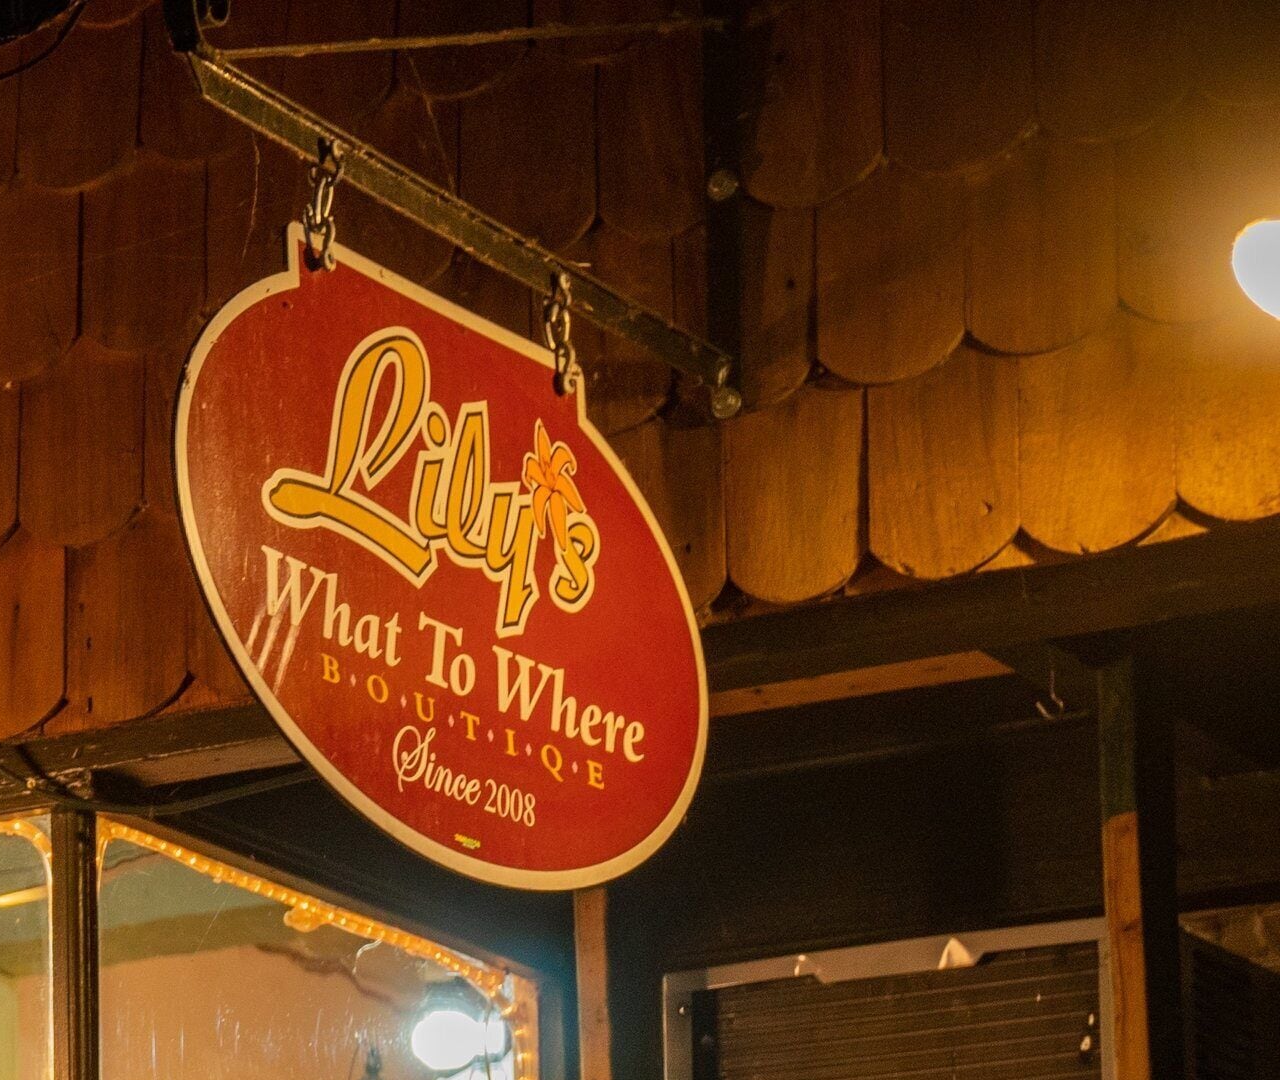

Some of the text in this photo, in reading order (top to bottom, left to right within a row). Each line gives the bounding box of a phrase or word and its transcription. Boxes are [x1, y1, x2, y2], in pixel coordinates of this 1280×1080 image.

[260, 546, 645, 763] What To Where
[392, 725, 536, 828] Since 2008
